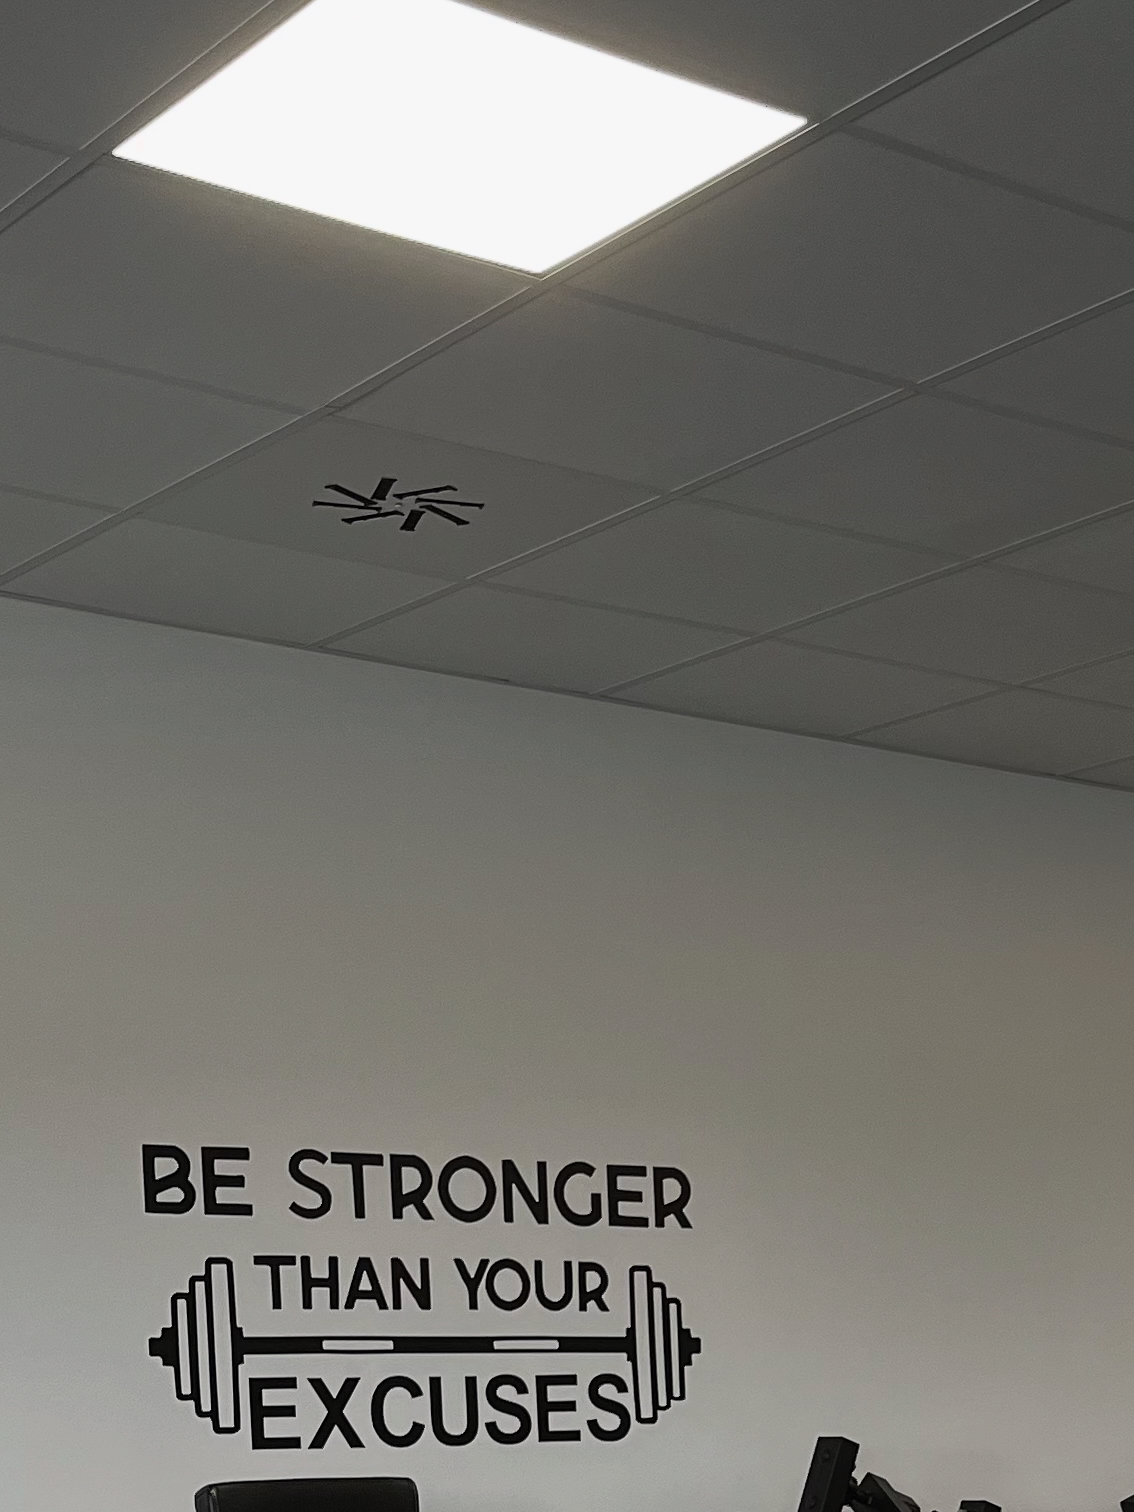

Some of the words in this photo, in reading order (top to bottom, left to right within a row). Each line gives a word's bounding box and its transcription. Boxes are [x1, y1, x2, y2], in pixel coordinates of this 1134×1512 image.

[142, 1144, 253, 1216] BE
[288, 1148, 693, 1229] STRONGER
[253, 1255, 432, 1311] THAN
[453, 1257, 610, 1312] YOUR
[249, 1373, 632, 1449] EXCUSES
